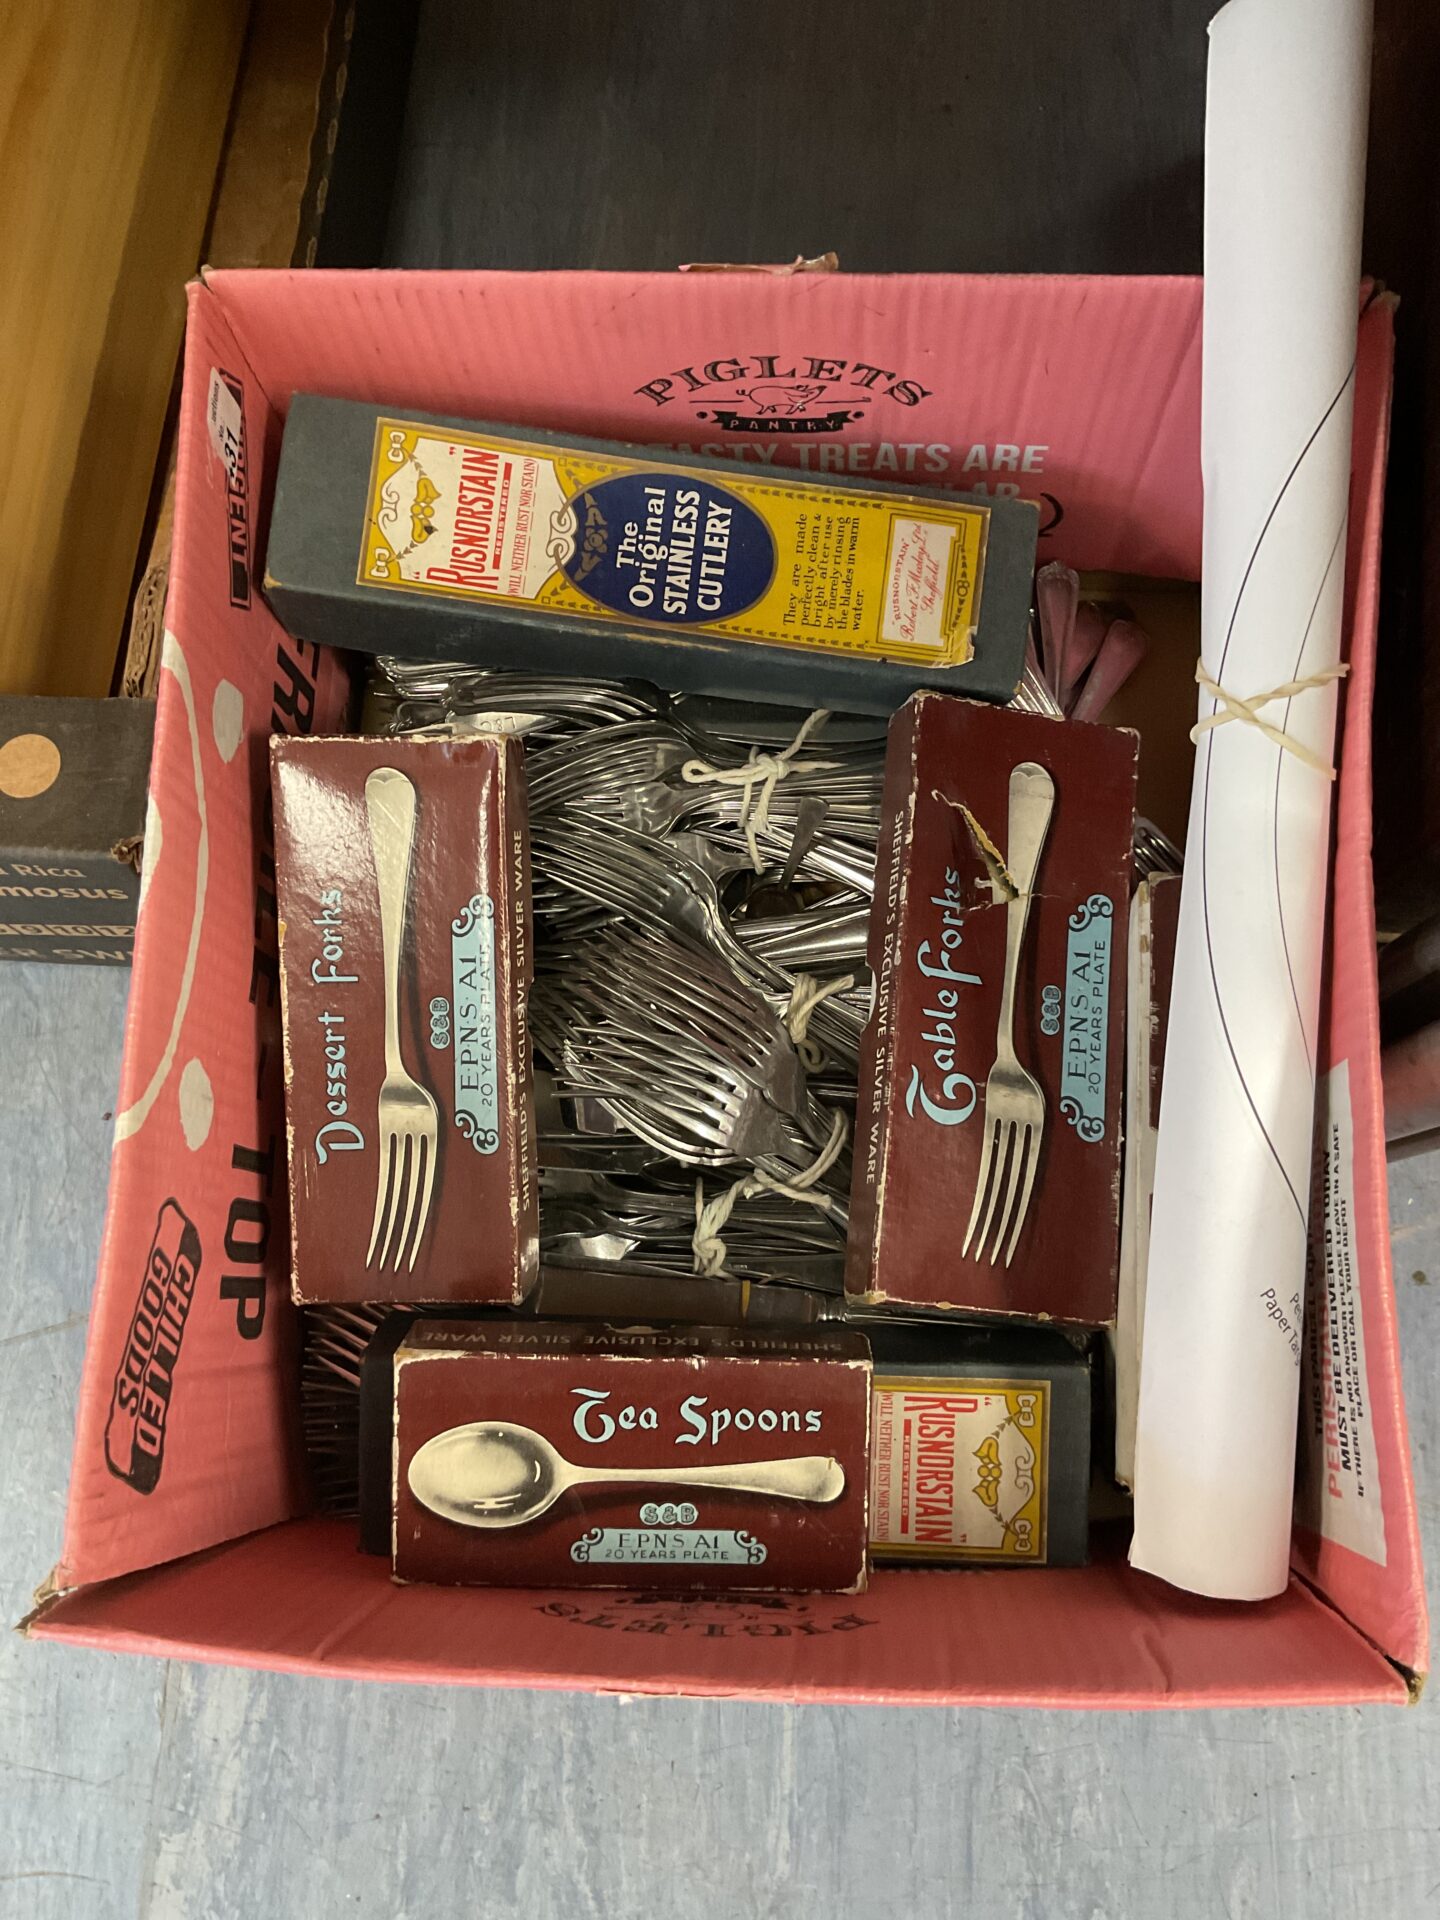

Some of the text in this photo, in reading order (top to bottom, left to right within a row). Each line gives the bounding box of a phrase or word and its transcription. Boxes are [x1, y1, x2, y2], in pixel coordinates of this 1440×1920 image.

[633, 355, 934, 407] PIGLETS
[730, 419, 838, 432] PANTRY
[791, 443, 950, 474] TREATS
[961, 445, 1049, 473] ARE
[495, 480, 509, 556] REGISTERED
[516, 509, 530, 535] RUST
[519, 491, 533, 508] NOR
[511, 533, 527, 573] NEITHER
[616, 521, 638, 568] The
[629, 487, 667, 608] Original
[662, 489, 700, 614] STAINLESS
[699, 501, 732, 611] CUTLERY
[807, 526, 820, 562] clean
[783, 514, 807, 626] They are made
[812, 516, 833, 627] bright after use
[824, 516, 851, 628] by merely rinsing
[836, 518, 860, 629] the blades in warm
[799, 566, 817, 626] perfectly
[852, 589, 864, 630] water.
[901, 599, 918, 641] Robert
[11, 864, 87, 878] Rica
[514, 830, 530, 1211] SHEFFIELD'S EXCLUSIVE SILVER WARE
[866, 811, 903, 1184] SHEFFIELD'S EXCLUSIVE SILVER WARE
[906, 866, 984, 1126] Table Forks
[1042, 987, 1060, 1033] S&B
[1088, 940, 1106, 1094] 20 YEARS PLATE
[311, 889, 364, 1164] Dessert Forks
[432, 998, 450, 1047] S&B
[480, 944, 493, 1107] 20 YEARS PLATE
[1332, 1123, 1340, 1161] SAFE
[1333, 1179, 1340, 1194] IN
[219, 1135, 276, 1340] TOP
[1333, 1199, 1342, 1245] LEAVE
[1326, 1229, 1341, 1357] DELIVERED
[1336, 1248, 1347, 1307] PLEASE
[118, 1247, 172, 1417] GOODS
[1260, 1288, 1291, 1333] Paper
[1341, 1199, 1364, 1417] PLACE OR CALL YOUR DEPOT
[136, 1254, 195, 1456] CHILLED
[423, 1331, 841, 1350] SHEFFIELD'S EXCLUSIVE SILVER WARE
[1341, 1310, 1351, 1377] ANSWER
[1333, 1364, 1343, 1395] BE
[1346, 1381, 1355, 1402] NO
[570, 1387, 823, 1445] Tea Spoons
[1337, 1403, 1352, 1471] MUST
[1350, 1407, 1357, 1422] IS
[879, 1420, 892, 1461] NEITHER
[1352, 1426, 1363, 1482] THERE
[878, 1463, 891, 1488] RUST
[878, 1489, 890, 1508] NOR
[902, 1435, 911, 1516] REGISTERED
[1357, 1484, 1366, 1497] IF
[643, 1504, 697, 1524] S&B
[605, 1549, 729, 1561] 20 YEARS PLATE
[618, 1533, 685, 1549] EPNS
[538, 1602, 878, 1638] PIGLETS
